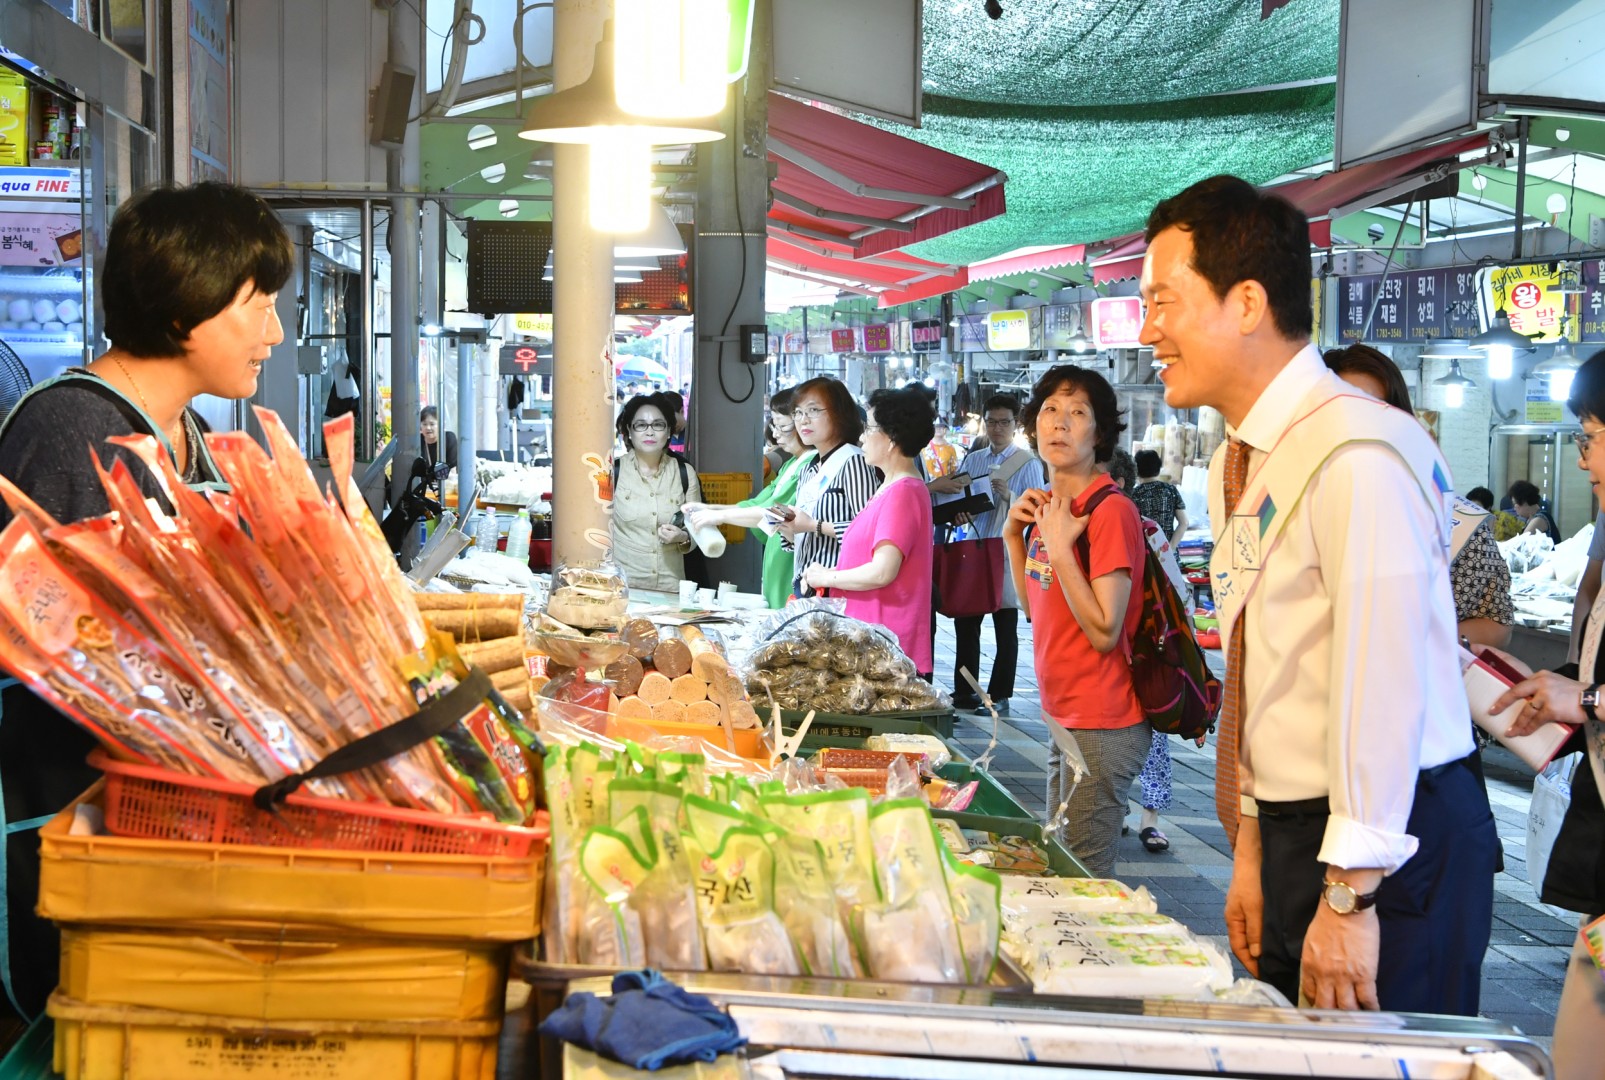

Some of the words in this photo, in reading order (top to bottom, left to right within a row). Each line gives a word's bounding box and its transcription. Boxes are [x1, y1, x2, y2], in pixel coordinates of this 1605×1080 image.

[0, 181, 31, 193] qua
[35, 179, 70, 193] FINE
[1417, 275, 1435, 297] 돼지
[1514, 284, 1539, 308] 왕
[1380, 303, 1397, 324] 재첩
[1417, 301, 1435, 323] 상회
[1590, 290, 1605, 316] 추
[1348, 305, 1363, 325] 식품
[1536, 307, 1556, 327] 발
[514, 347, 538, 372] 우
